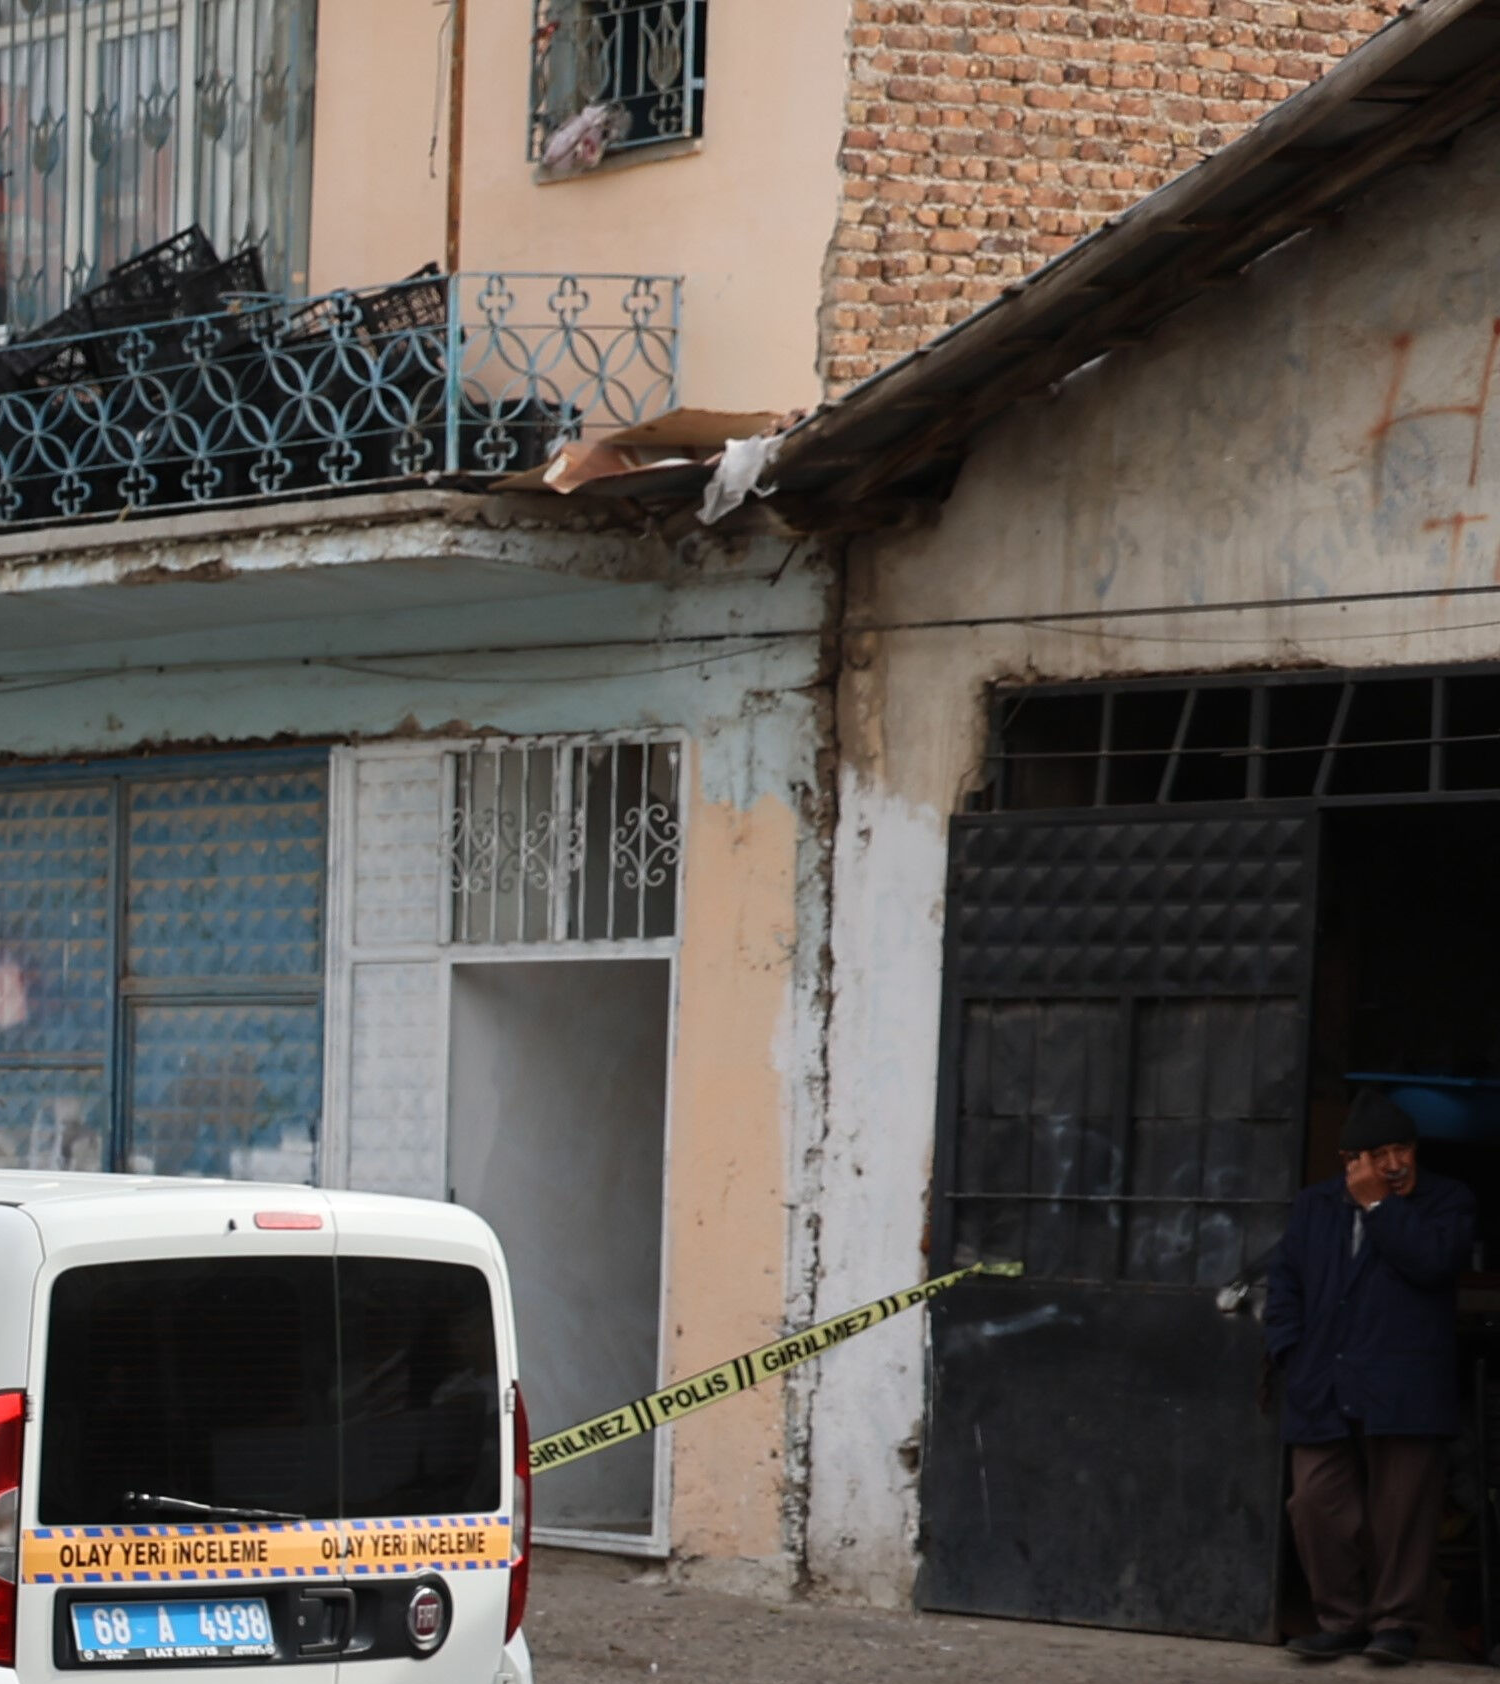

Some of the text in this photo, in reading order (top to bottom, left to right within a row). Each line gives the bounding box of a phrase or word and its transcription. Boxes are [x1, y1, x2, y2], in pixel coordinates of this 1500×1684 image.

[59, 1543, 113, 1568] OLAY
[321, 1536, 367, 1560] OLAY
[92, 1603, 268, 1645] 68 A 4938
